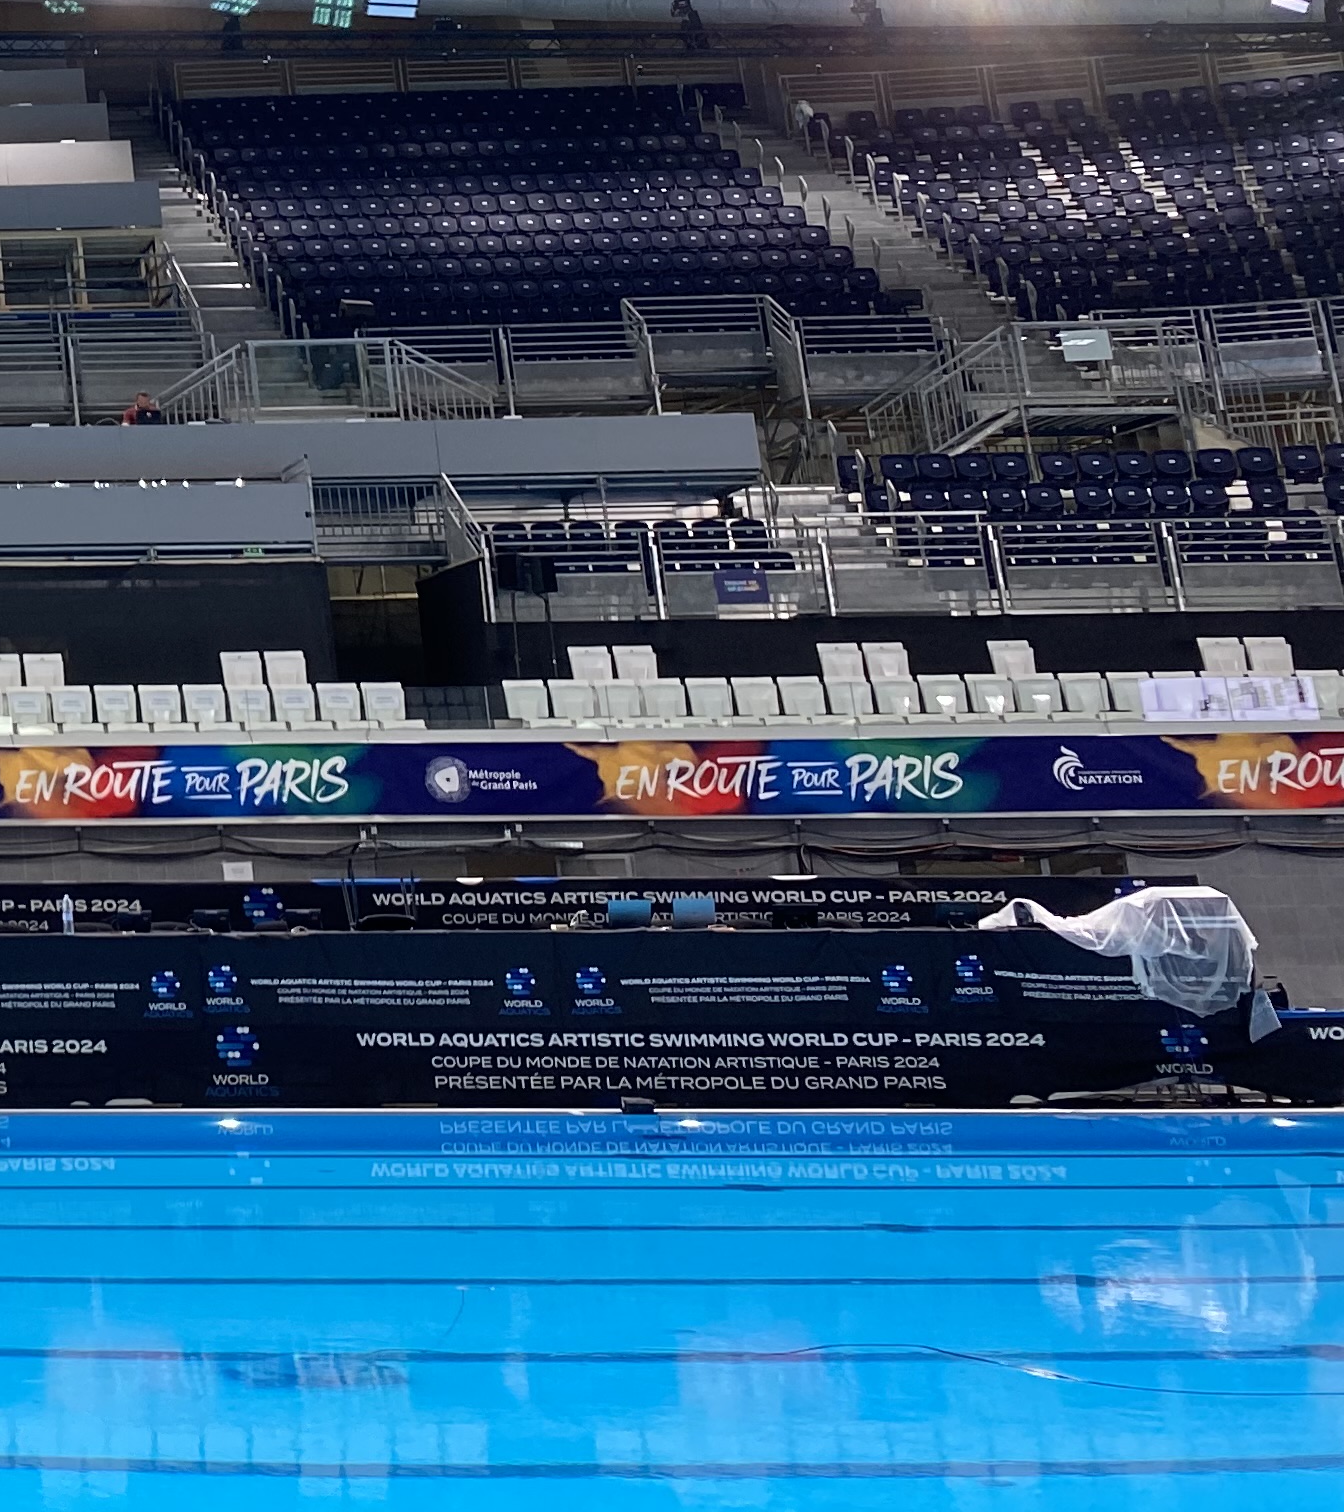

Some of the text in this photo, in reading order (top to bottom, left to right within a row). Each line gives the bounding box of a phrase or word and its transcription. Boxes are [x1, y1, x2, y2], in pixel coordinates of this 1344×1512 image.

[468, 768, 521, 782] Métropole
[616, 752, 964, 802] EN ROUTE POUR PARIS
[1218, 748, 1344, 795] EN ROU
[15, 755, 349, 807] EN ROUTE POUR PARIS
[479, 778, 511, 791] Grand
[512, 779, 538, 791] Paris
[1077, 774, 1144, 786] NATATION
[448, 891, 546, 906] AQUATICS
[550, 891, 639, 904] ARTISTIC
[643, 891, 748, 904] SWIMMING
[752, 890, 826, 903] WORLD
[830, 890, 872, 903] CUP
[889, 890, 949, 903] PARIS
[953, 890, 1007, 903] 2024
[91, 899, 142, 913] 2024
[442, 913, 498, 925] COUPE
[502, 913, 525, 925] DU
[868, 911, 912, 922] 2024
[149, 1002, 186, 1011] WORLD
[206, 996, 244, 1006] WORLD
[504, 999, 543, 1008] WORLD
[575, 998, 614, 1008] WORLD
[881, 996, 921, 1006] WORLD
[52, 1040, 107, 1054] 2024
[357, 1033, 435, 1047] WORLD
[439, 1033, 544, 1048] AQUATICS
[549, 1033, 645, 1047] ARTISTIC
[649, 1033, 764, 1047] SWIMMING
[768, 1033, 848, 1047] WORLD
[853, 1033, 898, 1046] CUP
[915, 1033, 982, 1046] PARIS
[986, 1033, 1045, 1046] 2024
[432, 1056, 492, 1068] COUPE
[497, 1057, 521, 1068] DU
[526, 1056, 591, 1068] MONDE
[595, 1057, 620, 1068] DE
[624, 1057, 710, 1068] NATATION
[715, 1057, 820, 1069] ARTISTIQUE
[836, 1056, 889, 1068] PARIS
[894, 1057, 940, 1068] 2024
[1156, 1063, 1214, 1074] WORLD
[213, 1074, 269, 1085] WORLD
[435, 1072, 946, 1090] PRÉSENTÉE PAR LA MÉTROPOLE DU GRAND PARIS
